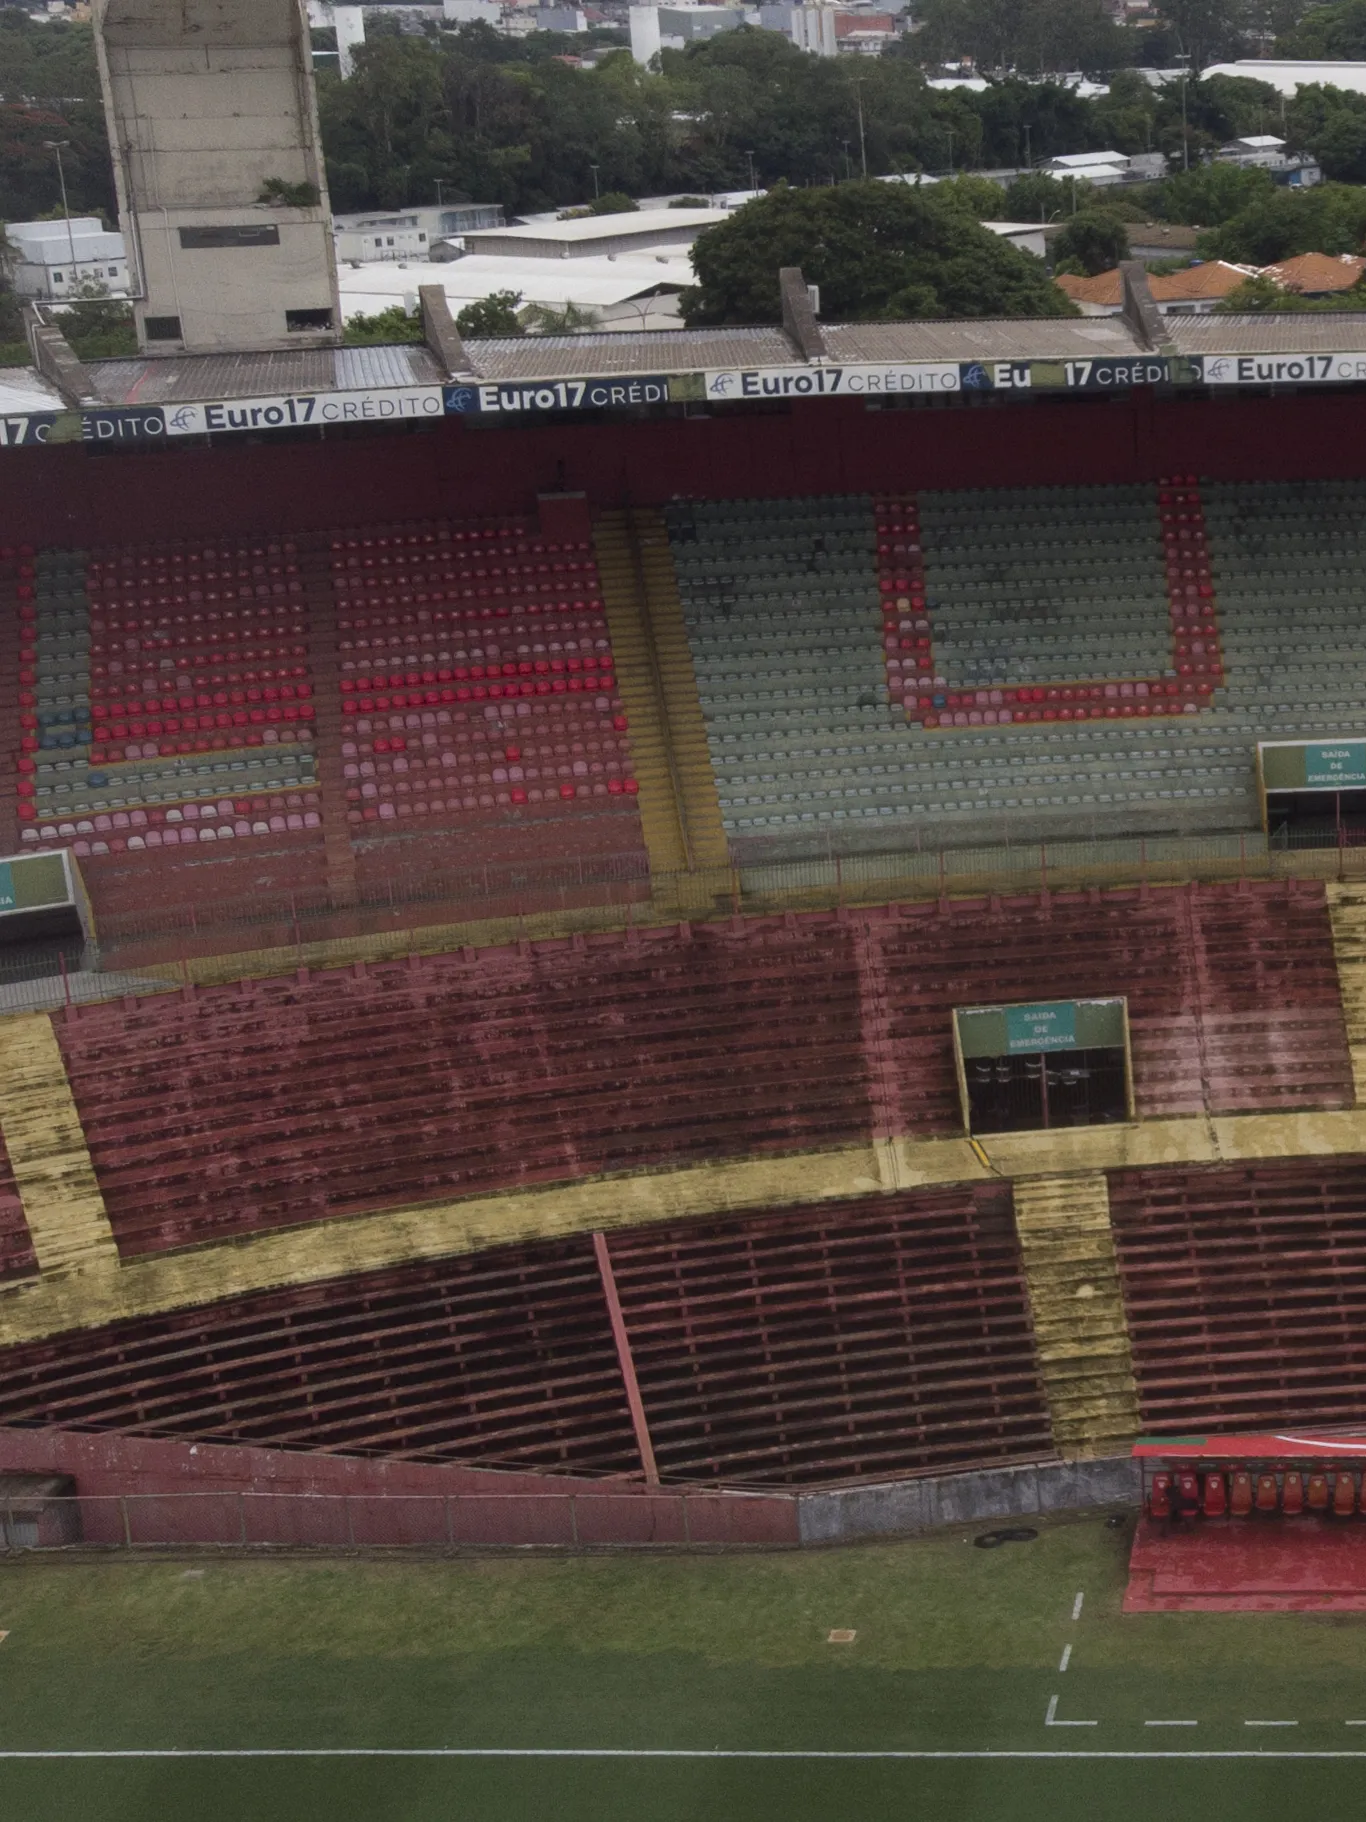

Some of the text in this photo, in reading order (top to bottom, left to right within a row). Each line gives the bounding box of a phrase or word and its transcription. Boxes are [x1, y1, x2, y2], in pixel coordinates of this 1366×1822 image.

[742, 363, 957, 396] Euro17 CRÉDITO
[1237, 355, 1333, 381] Euro17
[480, 382, 587, 411] Euro17
[205, 396, 440, 429] Euro17 CRÉDITO
[35, 416, 163, 442] CÉDITO
[1330, 762, 1343, 770] DE
[1033, 1024, 1049, 1034] DE
